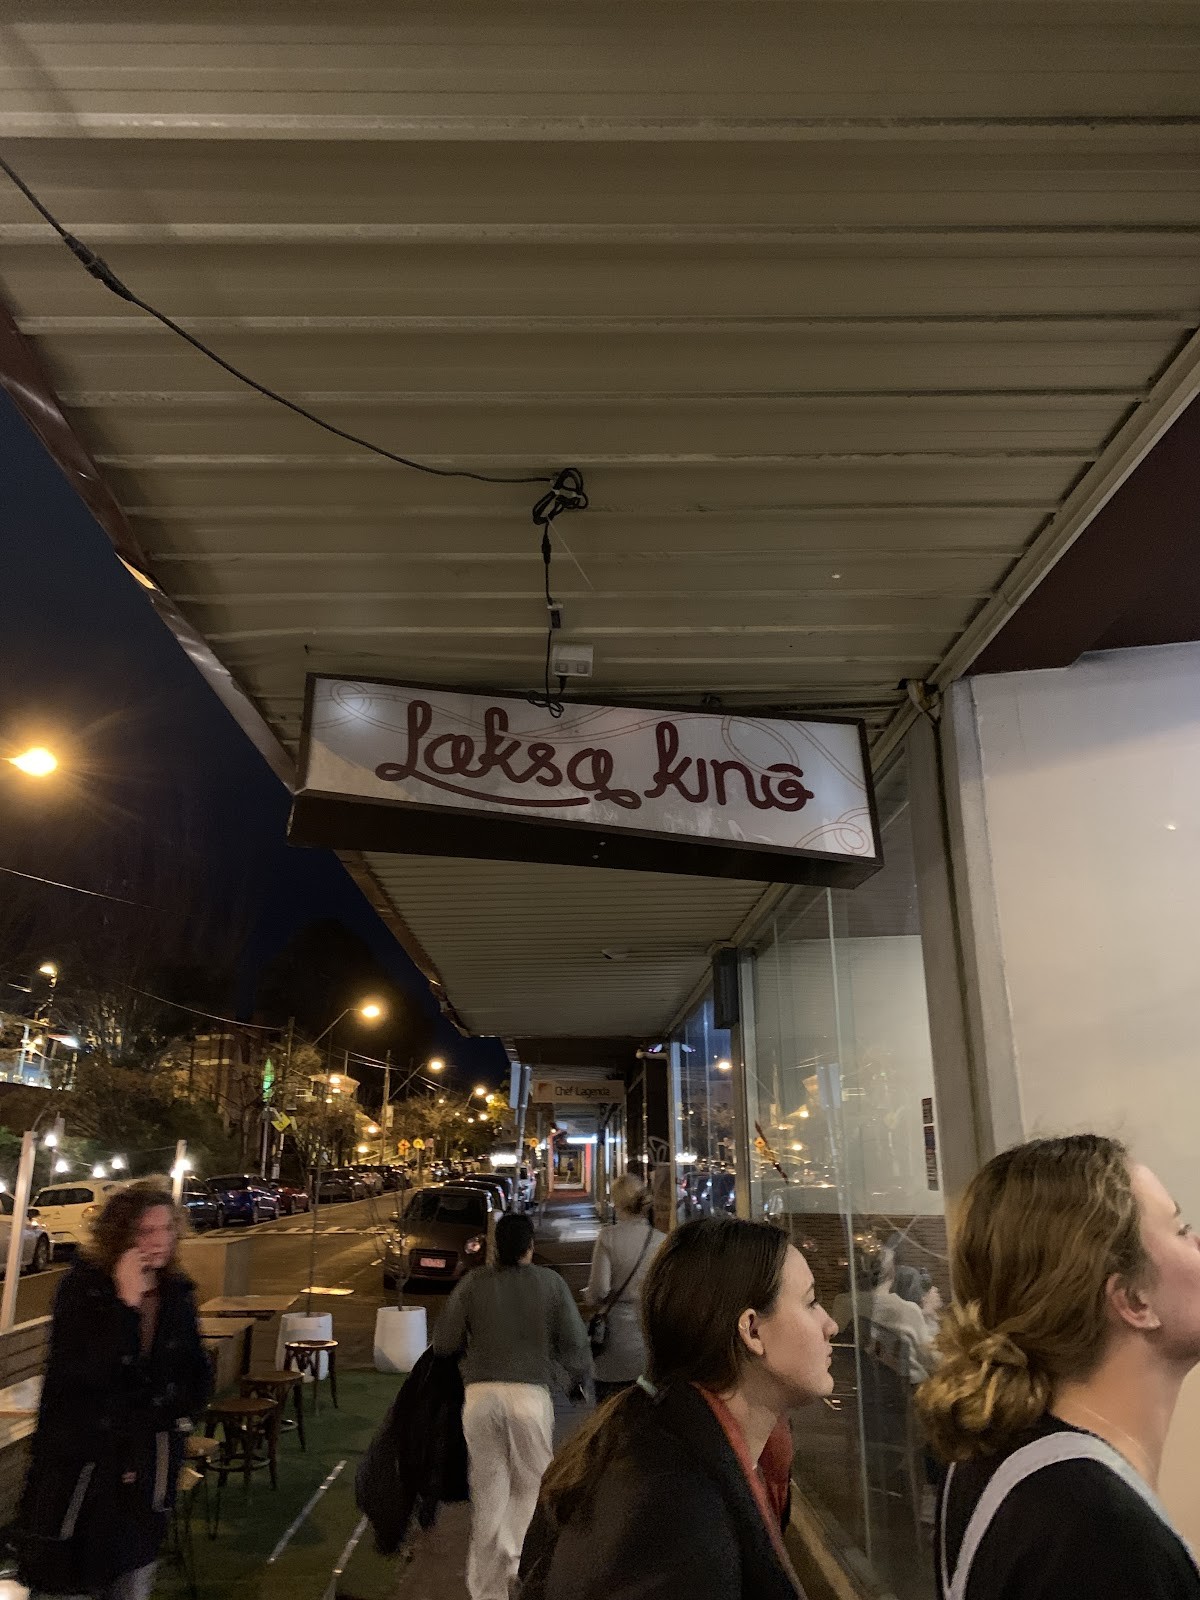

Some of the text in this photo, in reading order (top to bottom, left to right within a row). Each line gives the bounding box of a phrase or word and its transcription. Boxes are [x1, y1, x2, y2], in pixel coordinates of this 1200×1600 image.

[375, 700, 642, 809] Laksa
[555, 1086, 610, 1099] Chef Lagenda
